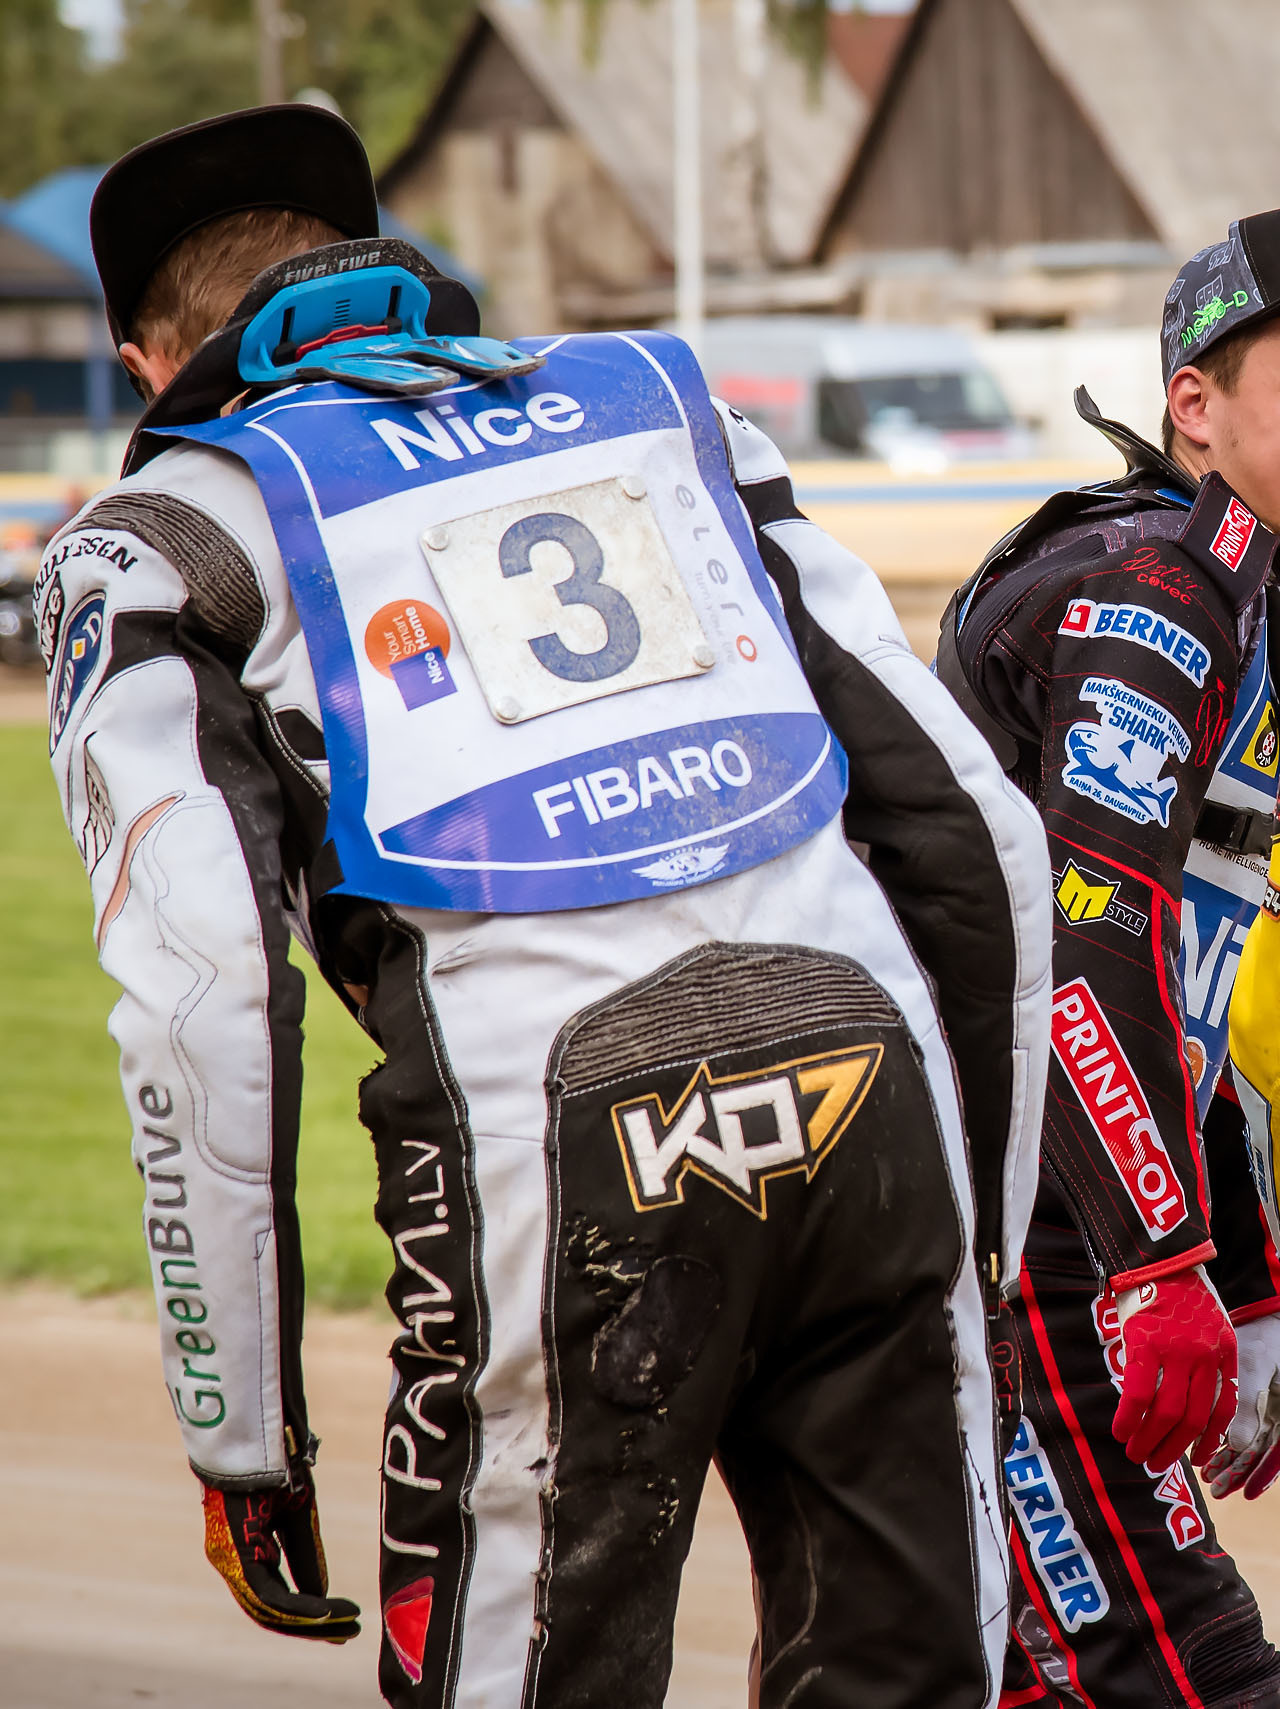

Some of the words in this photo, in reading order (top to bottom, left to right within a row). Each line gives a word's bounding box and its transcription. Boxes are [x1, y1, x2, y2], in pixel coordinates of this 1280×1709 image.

[283, 264, 327, 285] FIVE
[338, 251, 381, 273] FIVE
[370, 391, 584, 471] Nice
[499, 512, 641, 683] 3
[384, 631, 402, 662] Your
[392, 614, 417, 655] Smart
[405, 606, 430, 650] Home
[1094, 609, 1208, 682] BERNER
[425, 651, 445, 684] Nice
[1168, 720, 1191, 755] VEIKALS
[1256, 752, 1271, 767] PZM
[532, 739, 753, 839] FIBARO
[1104, 795, 1146, 822] DAUGAVPILS
[1199, 839, 1223, 857] HOME
[1223, 851, 1269, 878] INTELLIGENCE
[1105, 904, 1143, 931] STYLE
[1051, 993, 1178, 1226] PRINTSOL
